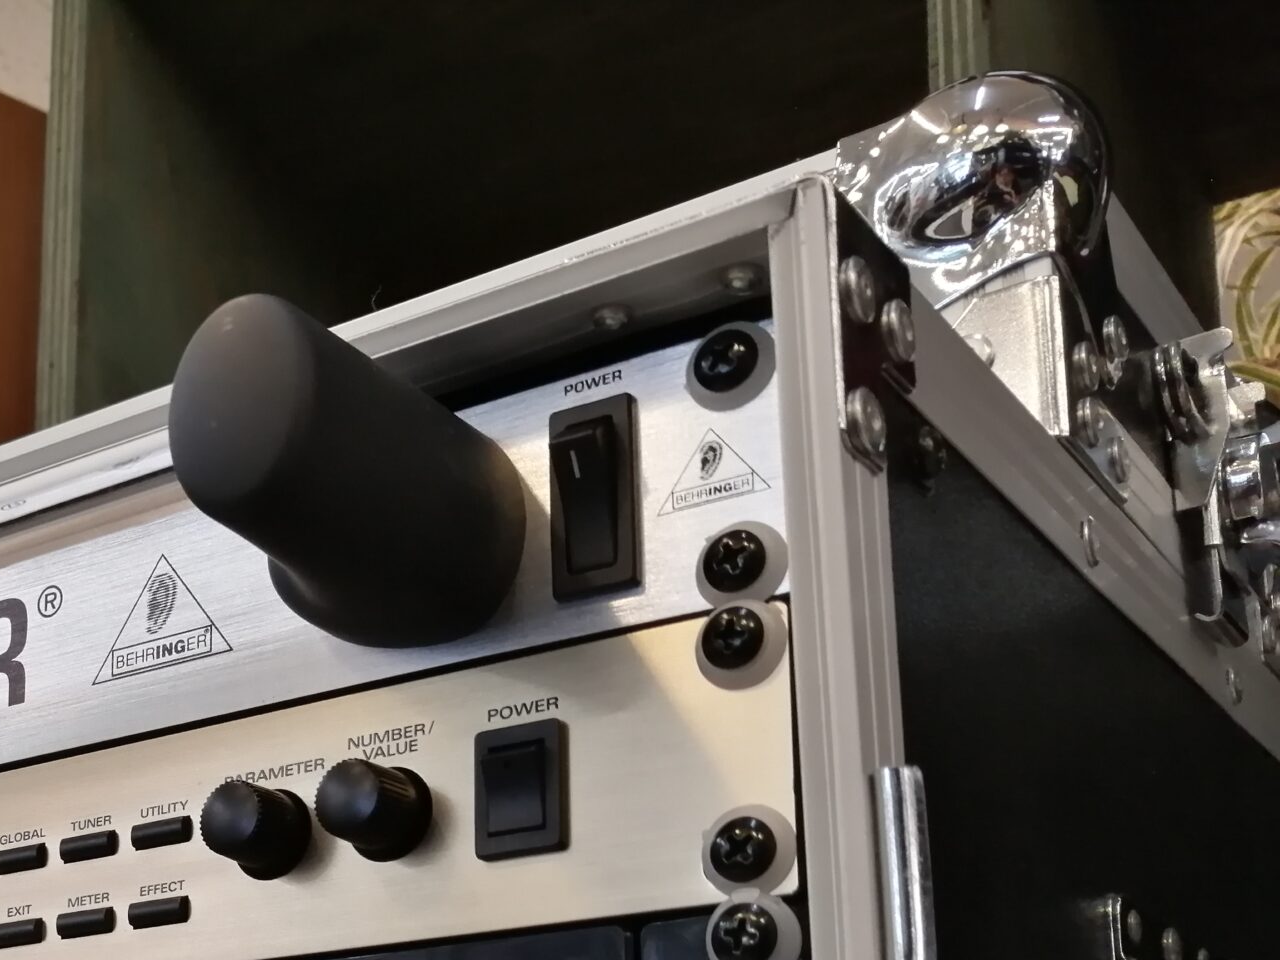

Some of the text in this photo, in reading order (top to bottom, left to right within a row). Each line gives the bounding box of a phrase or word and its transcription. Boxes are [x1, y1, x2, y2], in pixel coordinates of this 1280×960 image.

[564, 369, 623, 396] POWER
[674, 477, 752, 507] BEHRINGER
[487, 696, 560, 723] POWER
[347, 720, 435, 751] NUMBER/
[362, 738, 420, 762] VALUE
[140, 799, 189, 820] UTILITY
[71, 814, 112, 833] TUNER
[0, 827, 46, 846] GLOBAL
[139, 879, 185, 898] EFFECT
[66, 891, 110, 909] METER
[6, 904, 32, 918] EXIT
